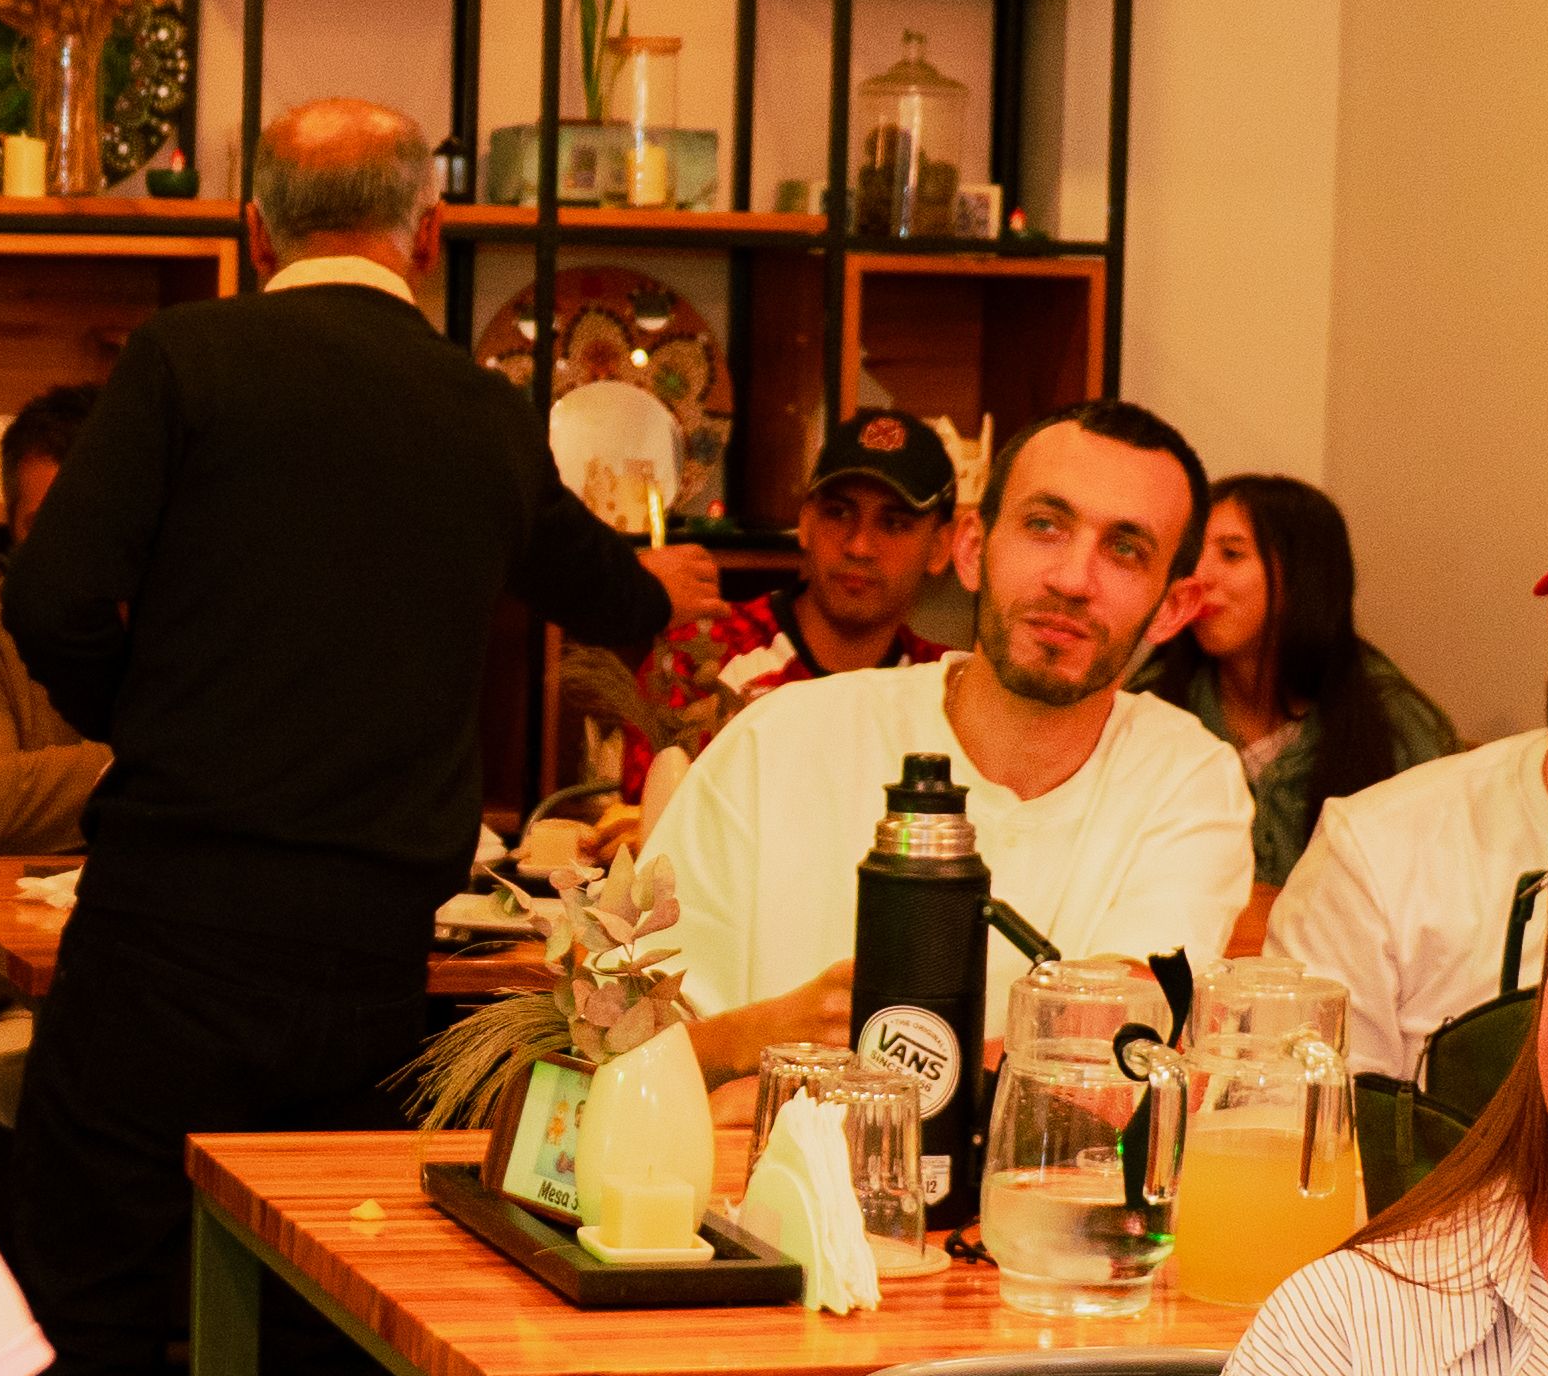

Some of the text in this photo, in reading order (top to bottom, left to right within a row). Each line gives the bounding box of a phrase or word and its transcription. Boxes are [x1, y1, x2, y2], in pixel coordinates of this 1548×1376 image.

[878, 1023, 947, 1080] VANS
[537, 1179, 570, 1208] Mesa
[926, 1180, 938, 1194] 12
